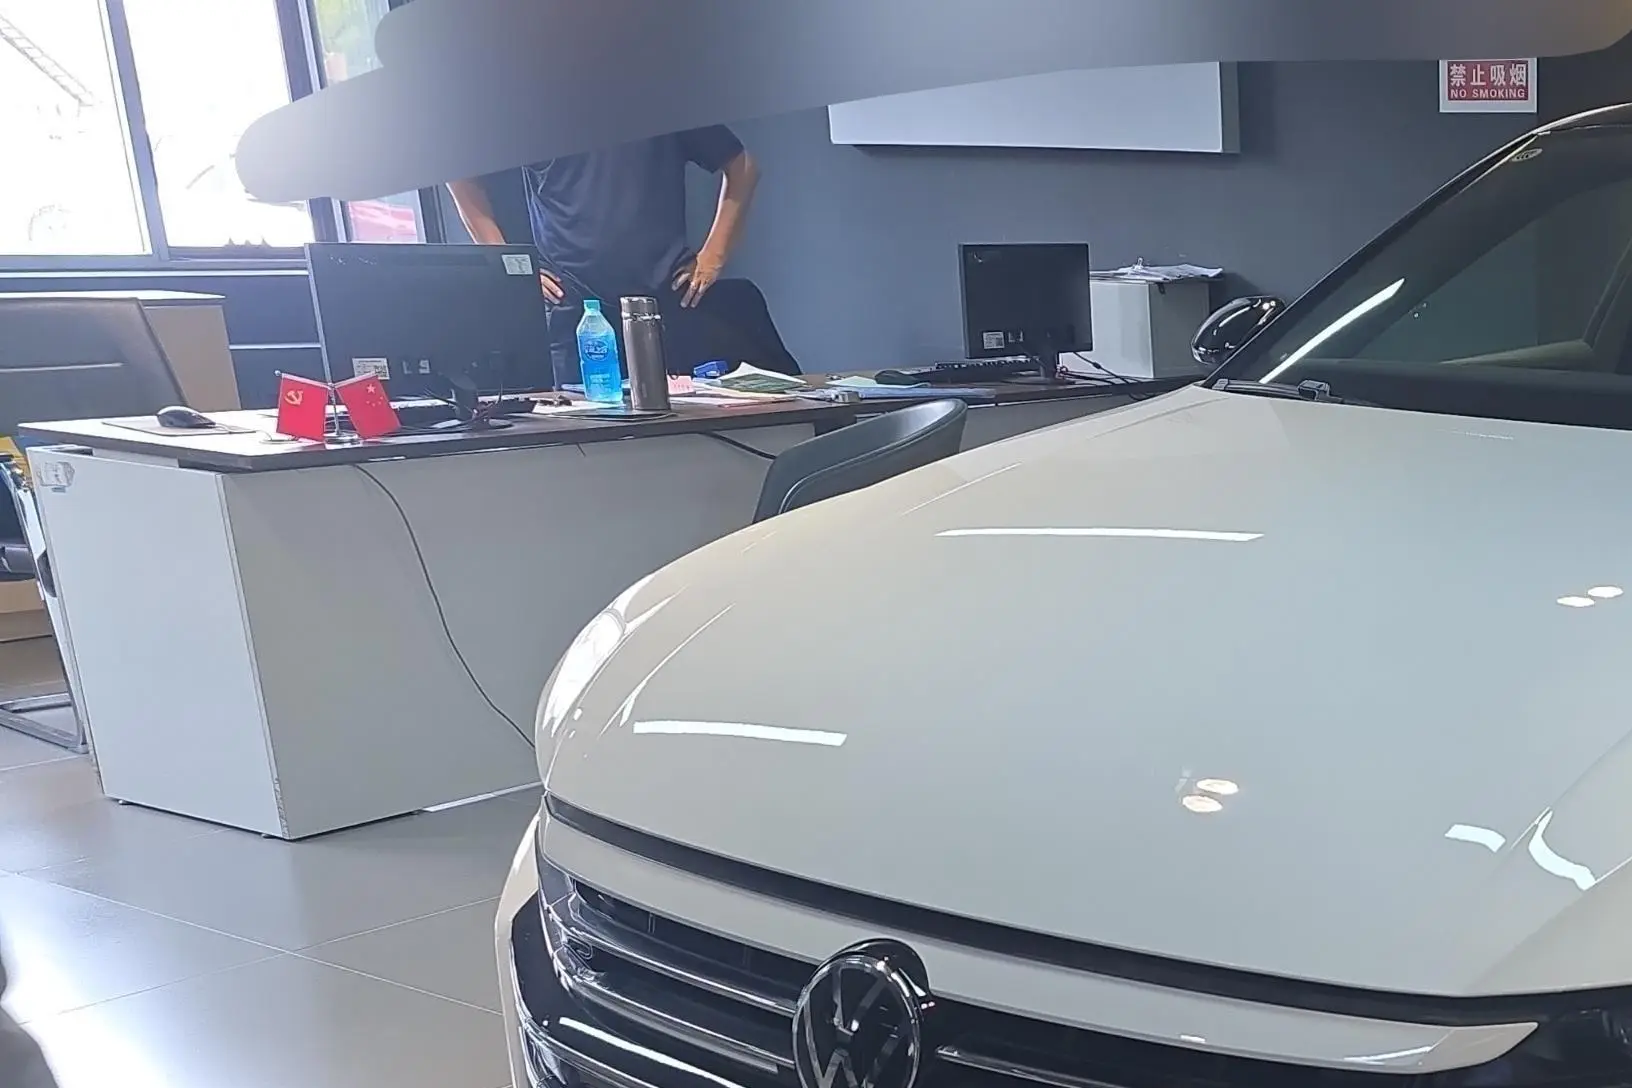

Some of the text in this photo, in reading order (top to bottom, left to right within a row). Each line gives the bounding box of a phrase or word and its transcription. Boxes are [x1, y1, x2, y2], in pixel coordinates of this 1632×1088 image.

[1450, 63, 1527, 87] 禁止吸烟
[1450, 88, 1525, 99] NO SMOKING
